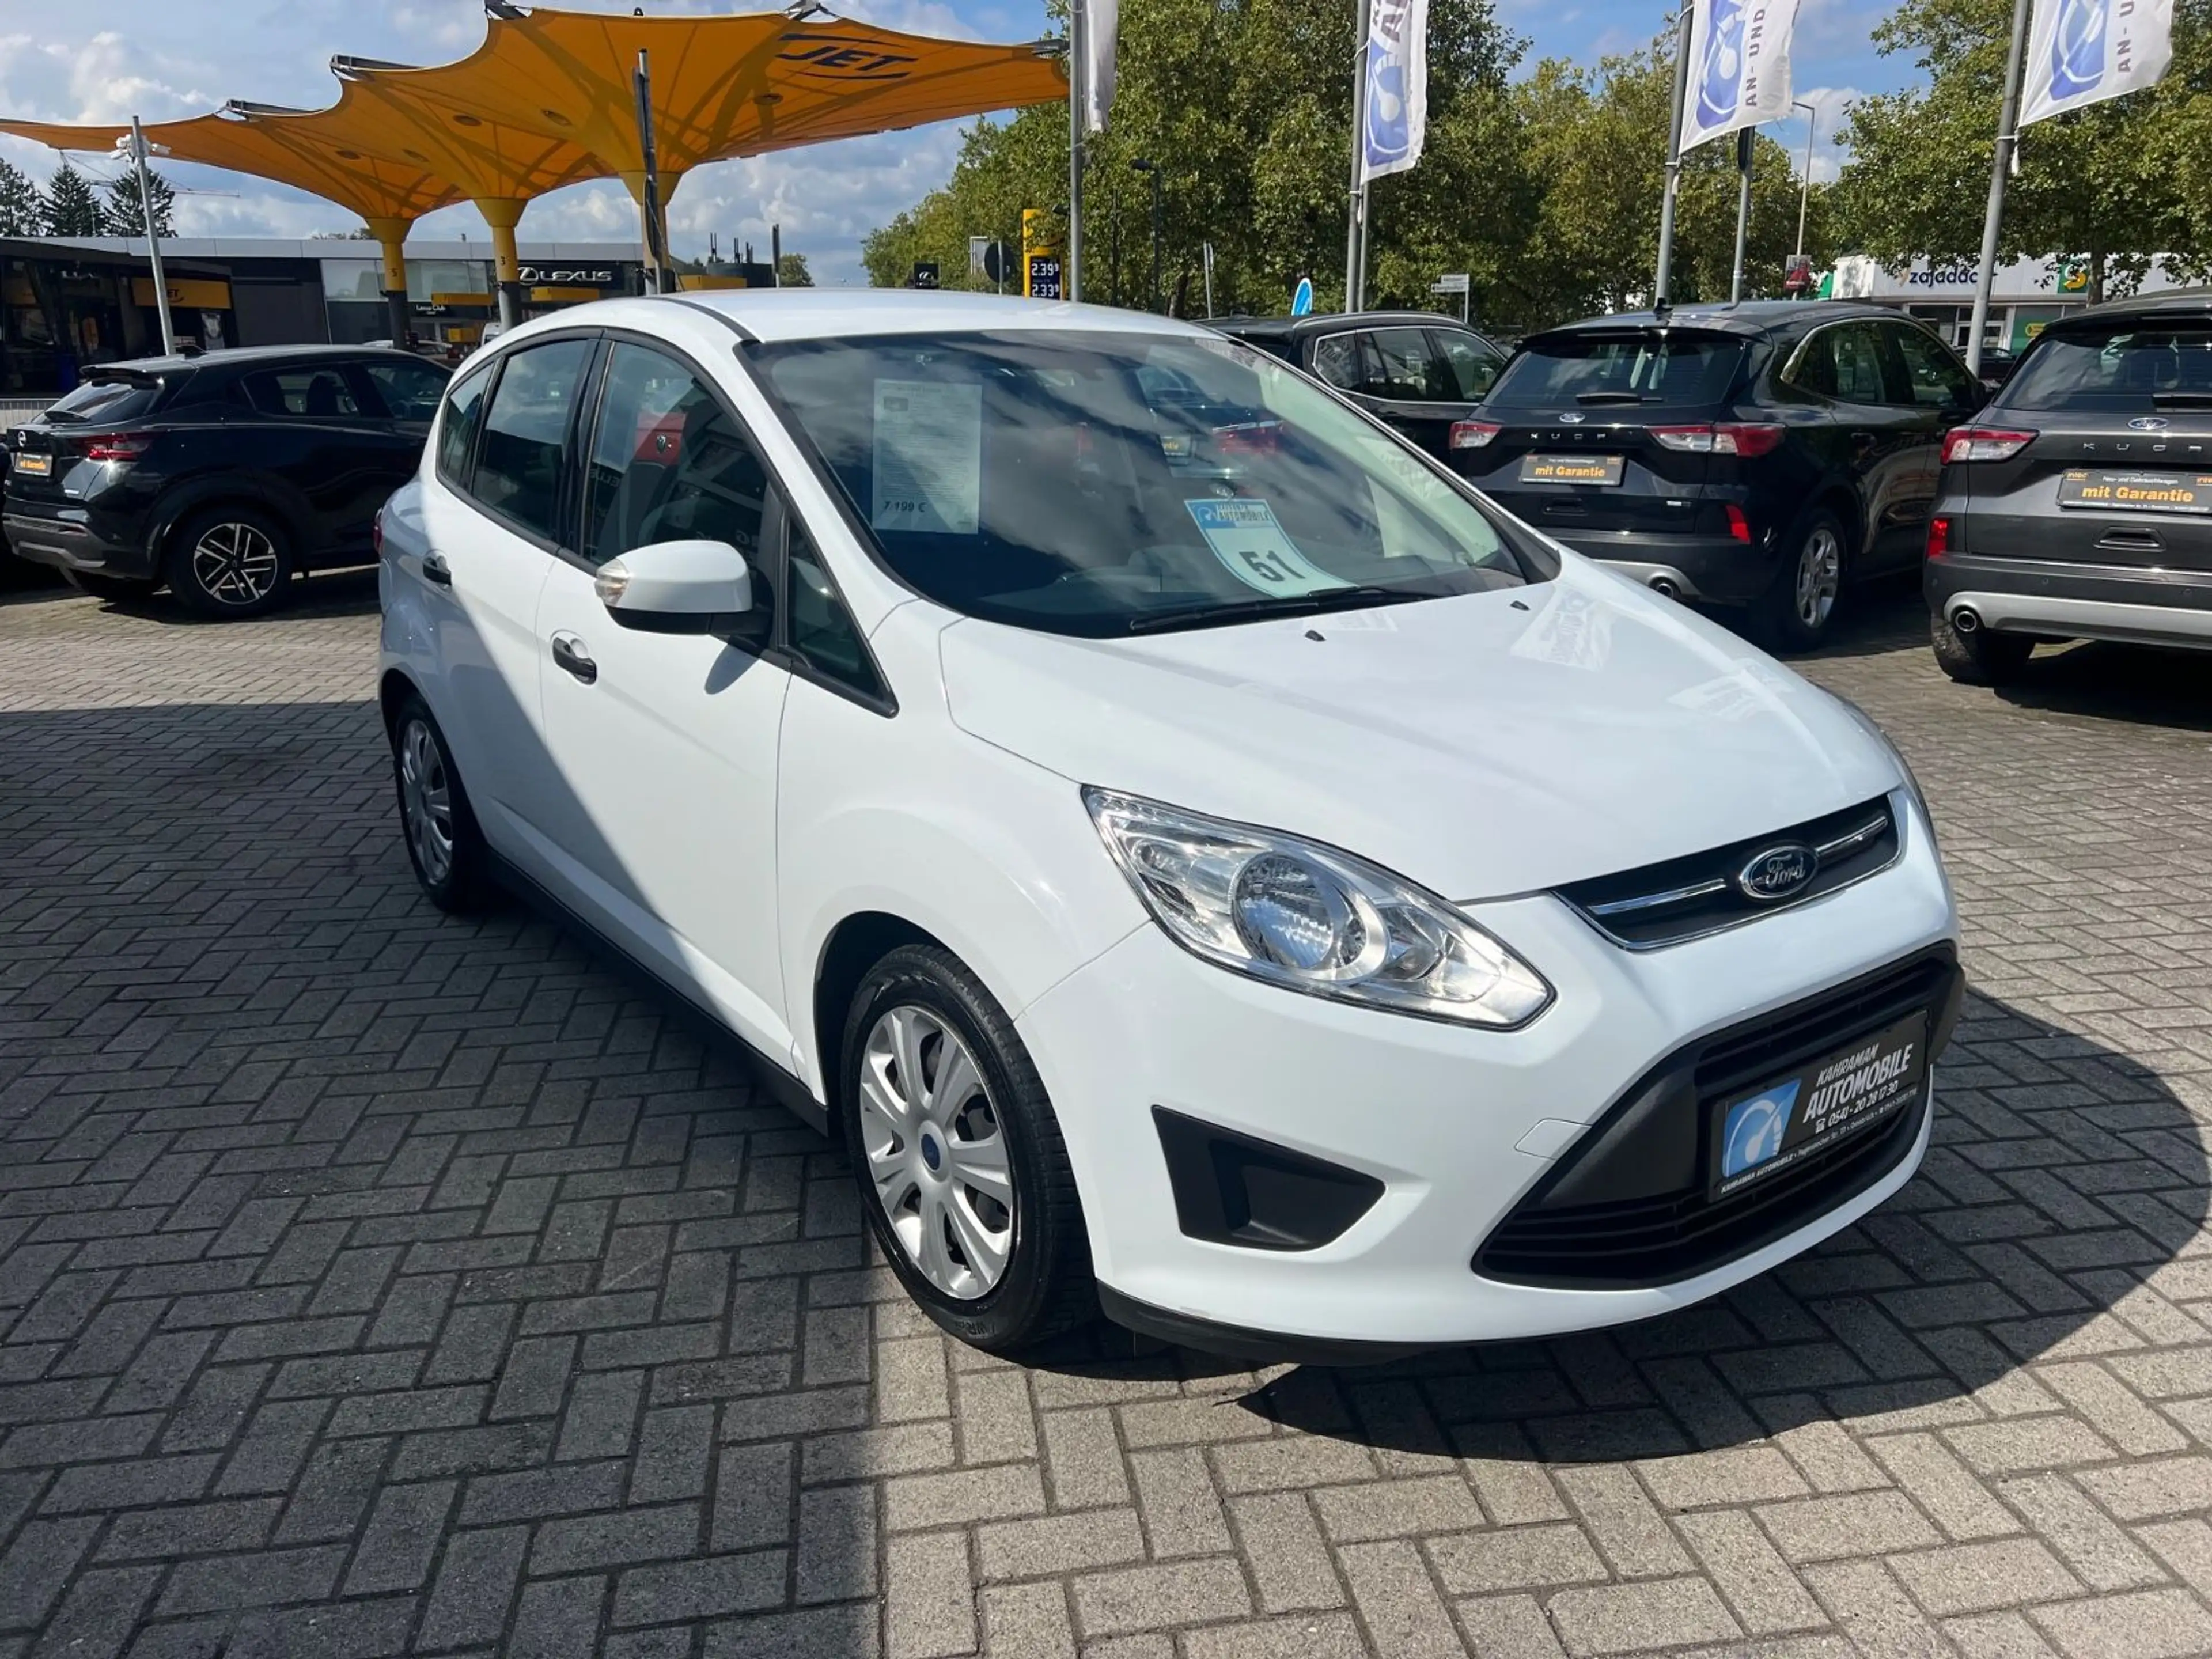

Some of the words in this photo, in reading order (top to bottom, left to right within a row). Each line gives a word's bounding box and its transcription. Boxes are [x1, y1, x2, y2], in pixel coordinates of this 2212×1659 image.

[775, 46, 919, 71] JET
[540, 271, 612, 282] LEXUS
[1909, 270, 1980, 287] zajadac
[1535, 465, 1554, 476] mit
[1556, 466, 1606, 477] Garantie
[2081, 486, 2111, 498] mit
[2115, 486, 2194, 503] Garantie
[1239, 550, 1306, 582] 51
[1765, 852, 1806, 888] Ford
[1816, 1043, 1880, 1088] KAHRAMAN
[1802, 1043, 1914, 1124] AUTOMOBILE
